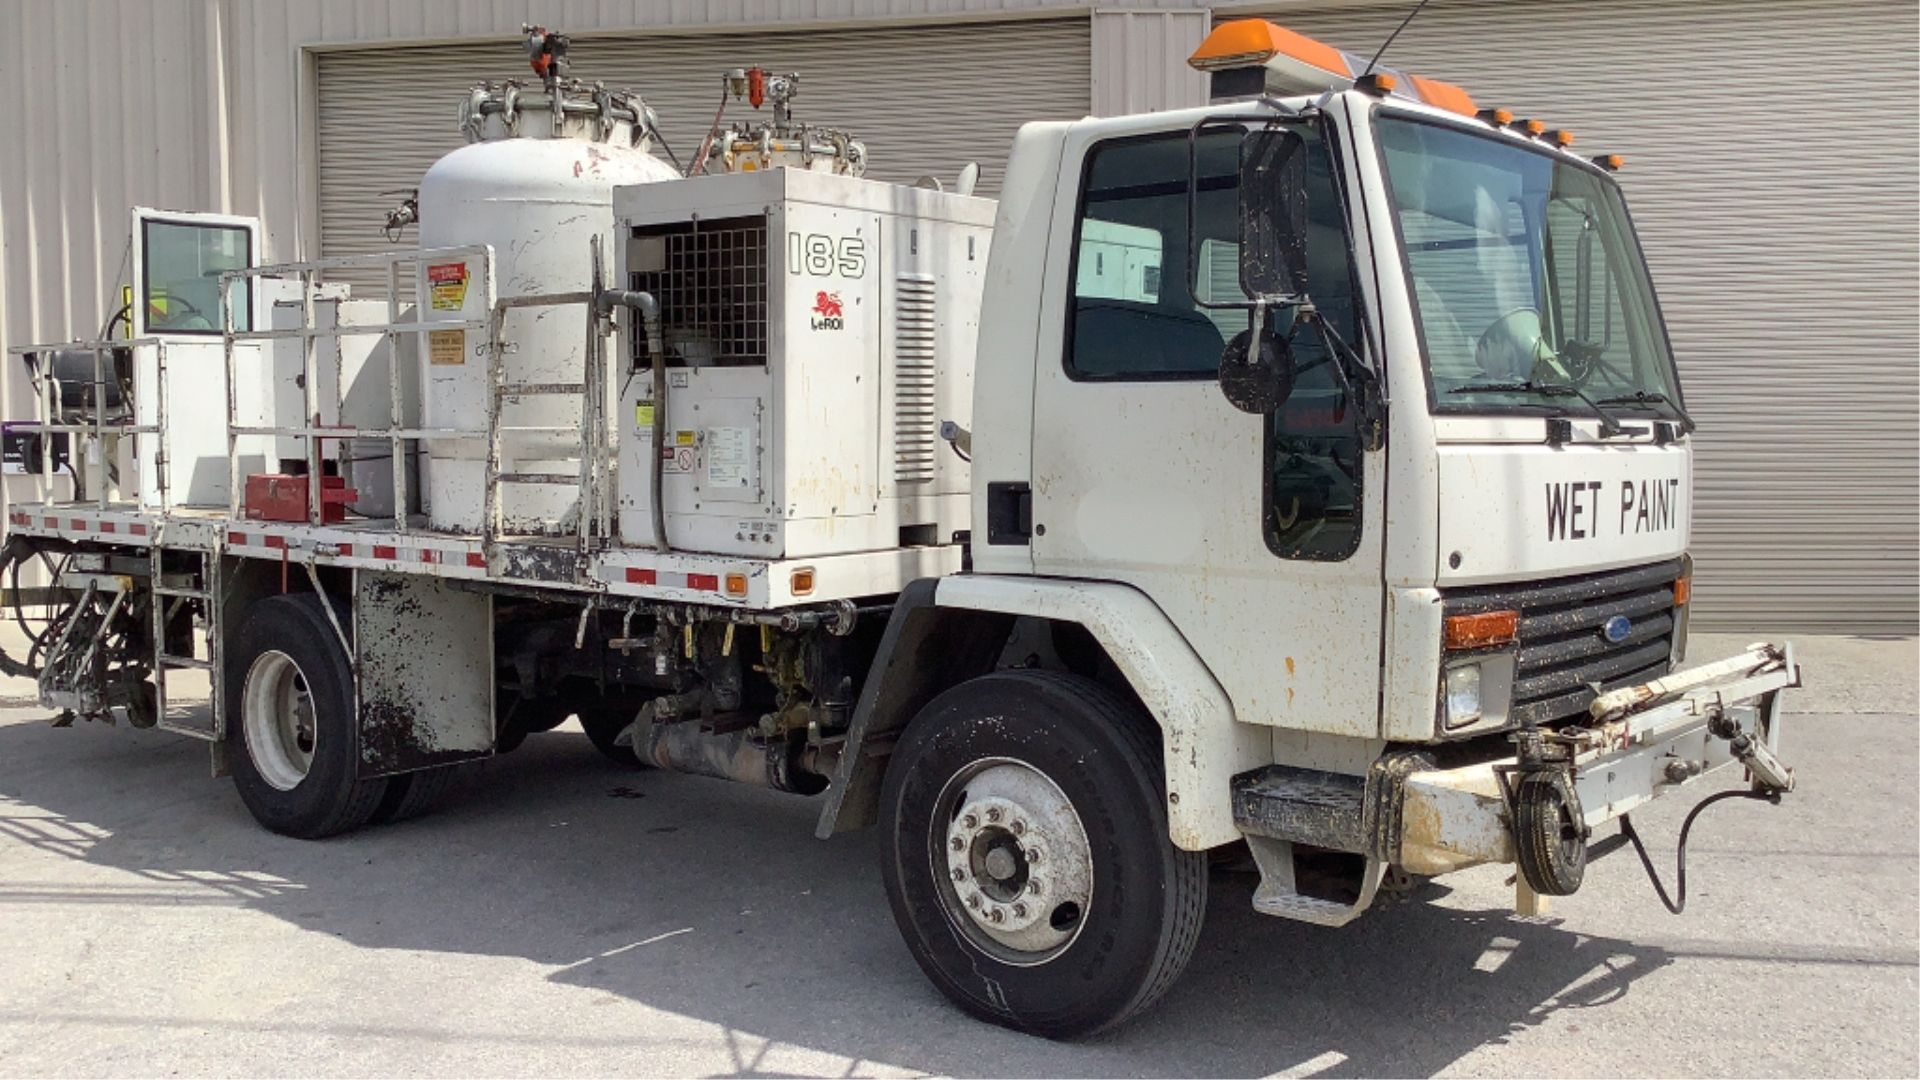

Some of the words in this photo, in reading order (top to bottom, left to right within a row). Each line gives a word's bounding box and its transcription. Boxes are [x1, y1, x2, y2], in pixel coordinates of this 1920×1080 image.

[789, 232, 865, 279] 185
[1546, 481, 1602, 541] WET
[1620, 479, 1678, 534] PAINT
